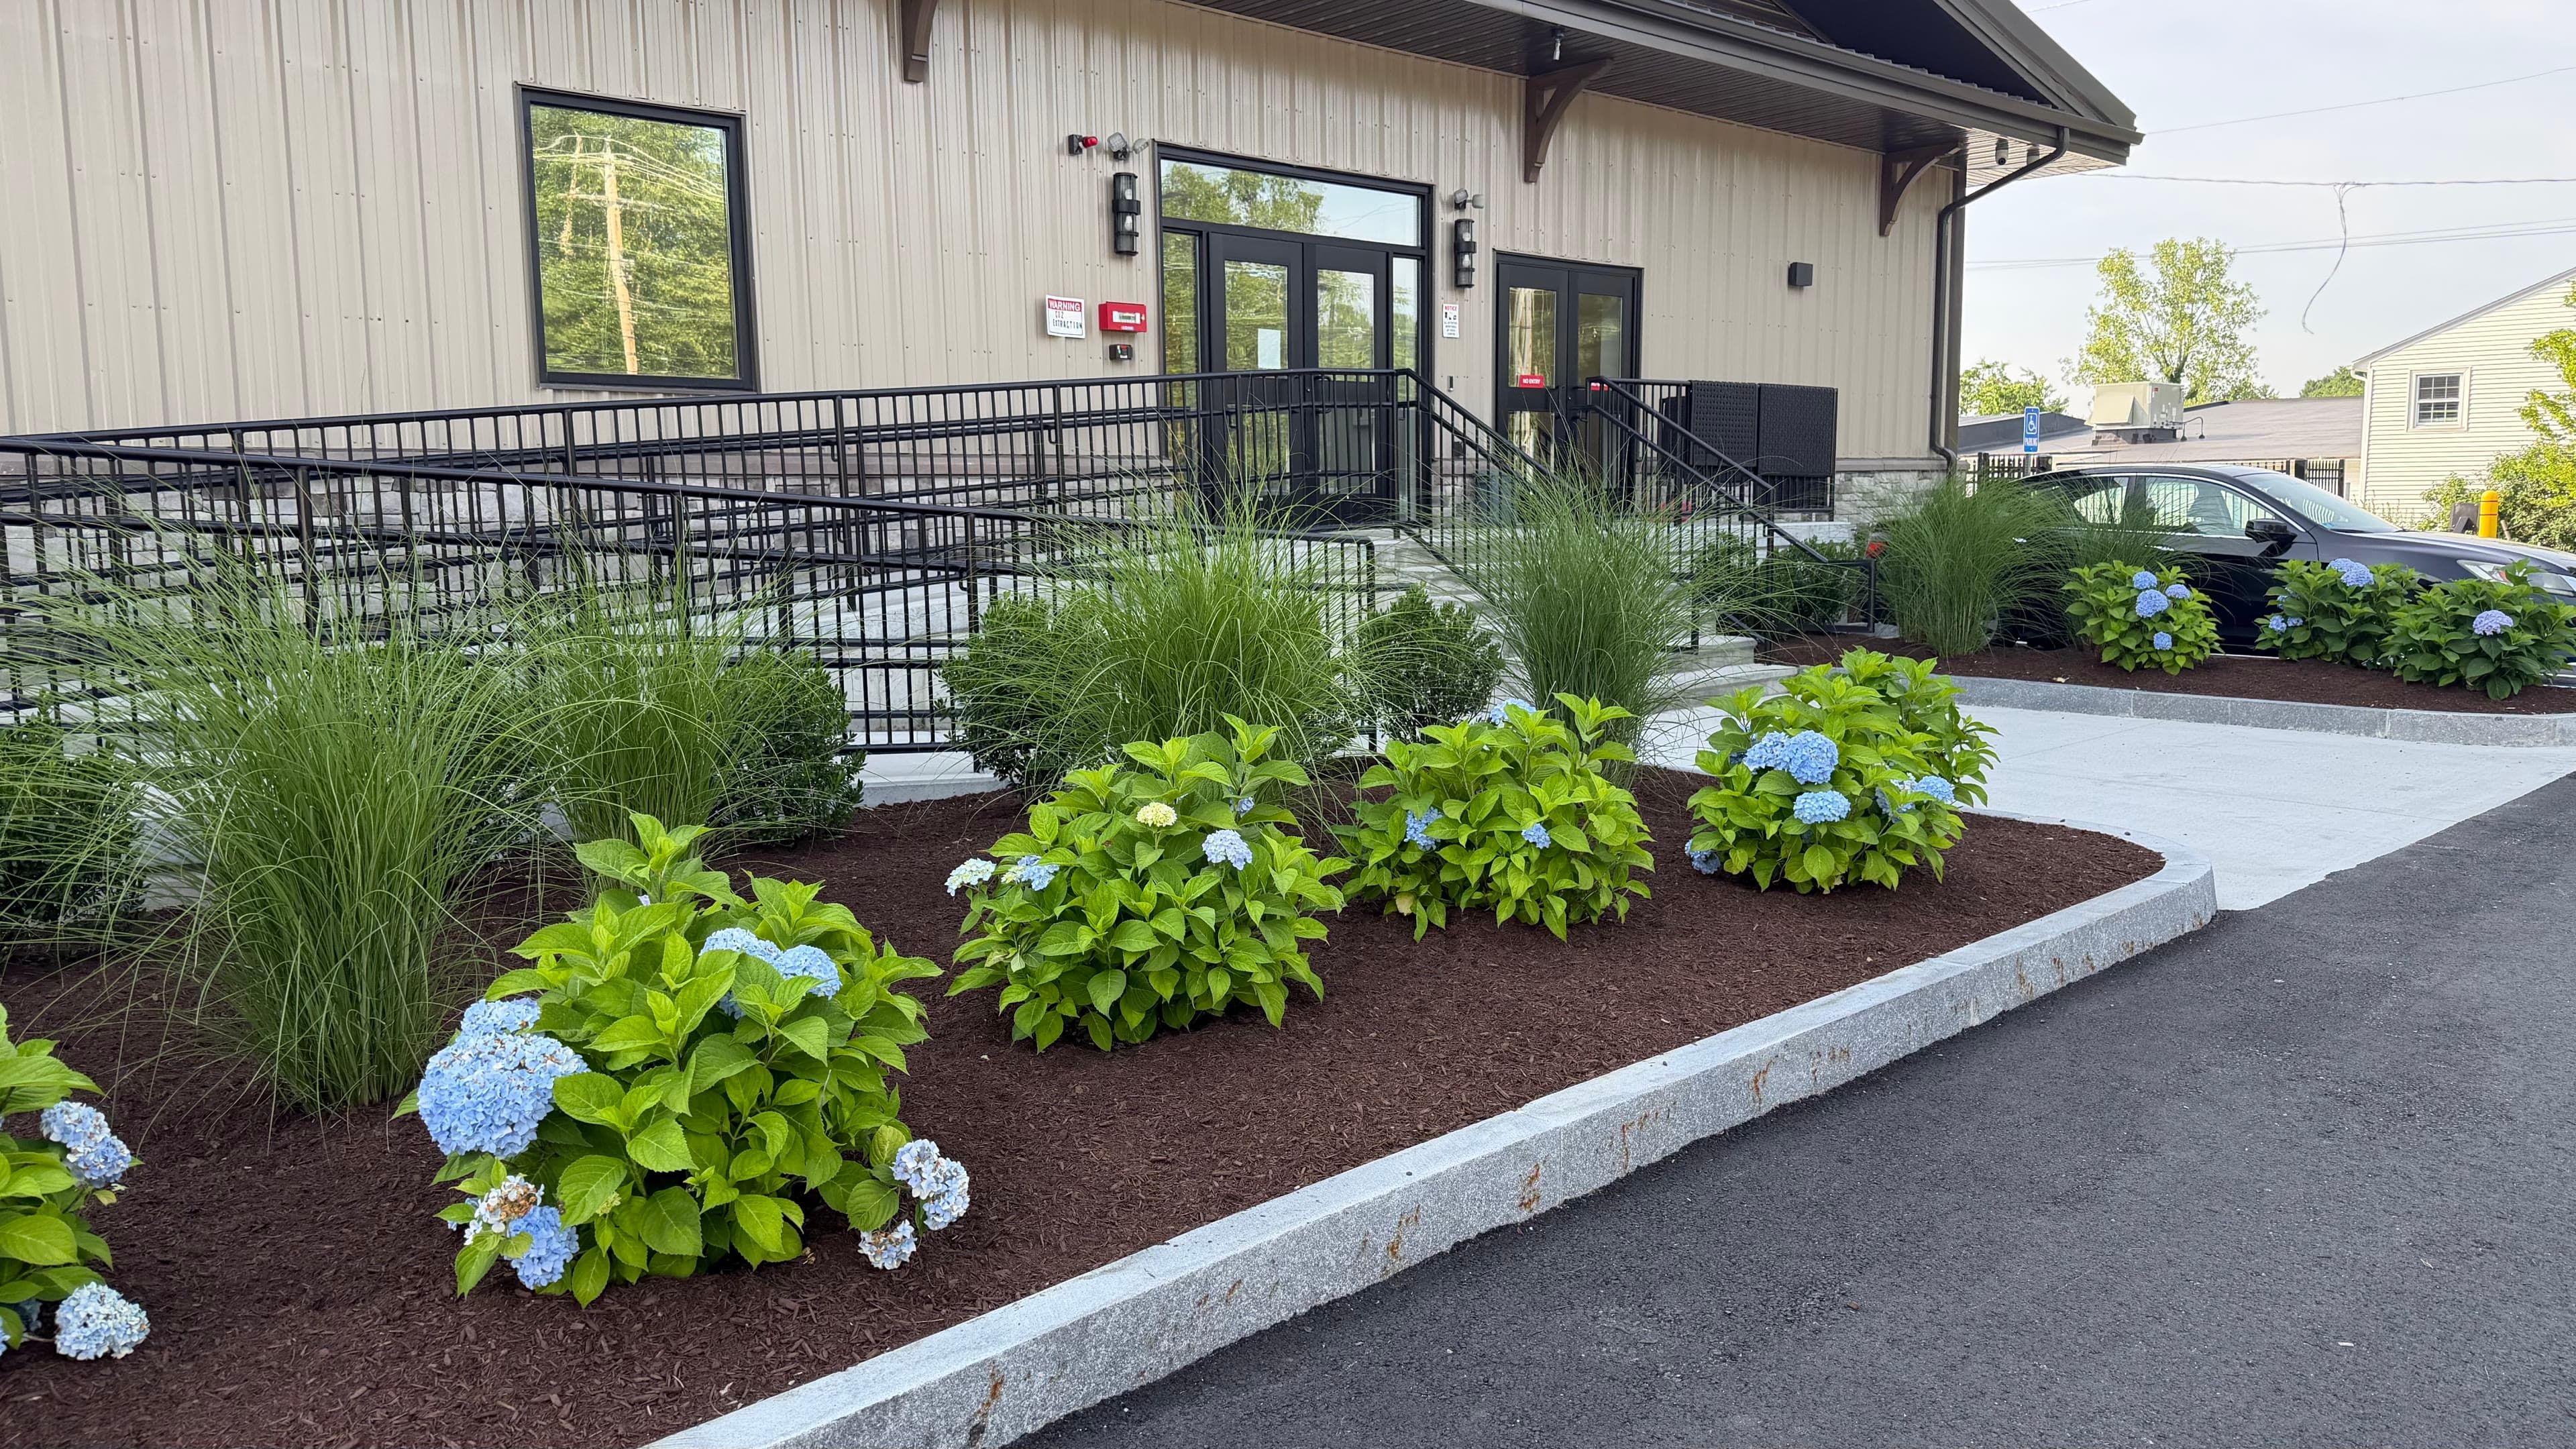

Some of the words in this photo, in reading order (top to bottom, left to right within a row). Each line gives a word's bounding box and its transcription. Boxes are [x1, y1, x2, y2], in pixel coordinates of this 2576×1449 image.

[1049, 300, 1081, 311] WARNING
[1053, 319, 1083, 329] EXTRACTION
[2025, 437, 2038, 446] PARKING
